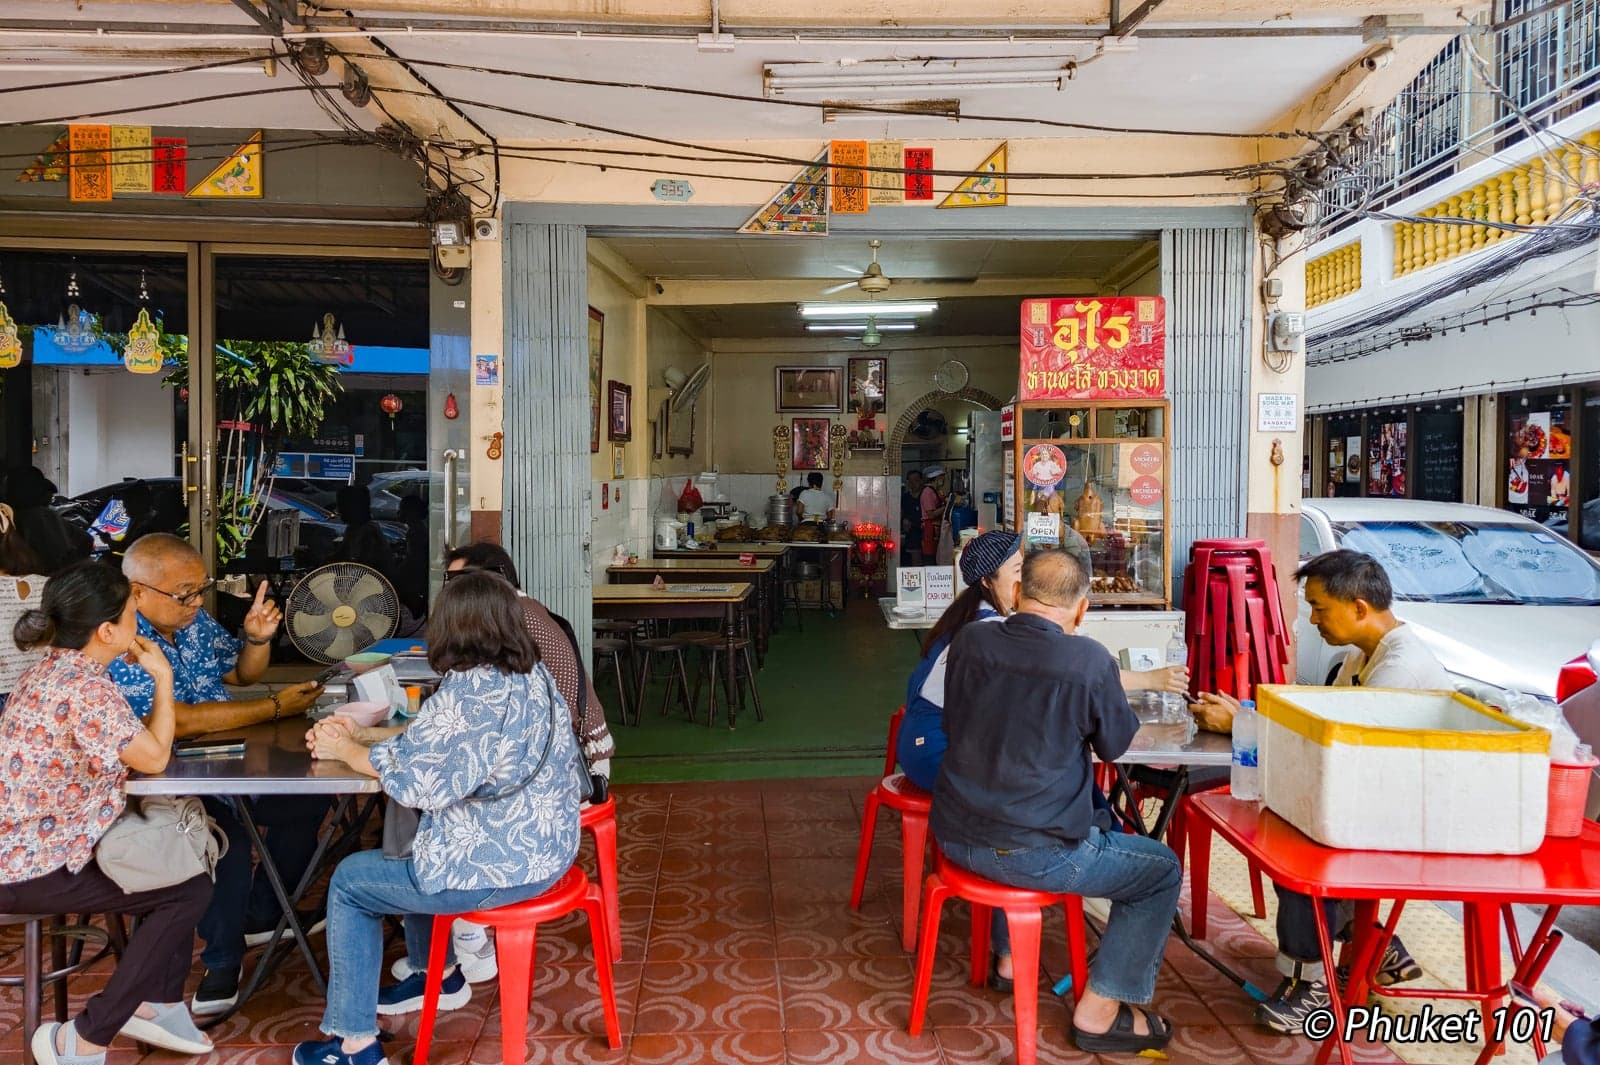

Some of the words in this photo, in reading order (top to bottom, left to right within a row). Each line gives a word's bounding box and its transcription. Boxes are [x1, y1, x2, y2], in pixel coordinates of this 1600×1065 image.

[1053, 300, 1133, 363] อุไร
[1026, 361, 1097, 391] ห่านพะโล้
[1097, 368, 1161, 391] ทรงวาด
[1030, 527, 1056, 536] OPEN
